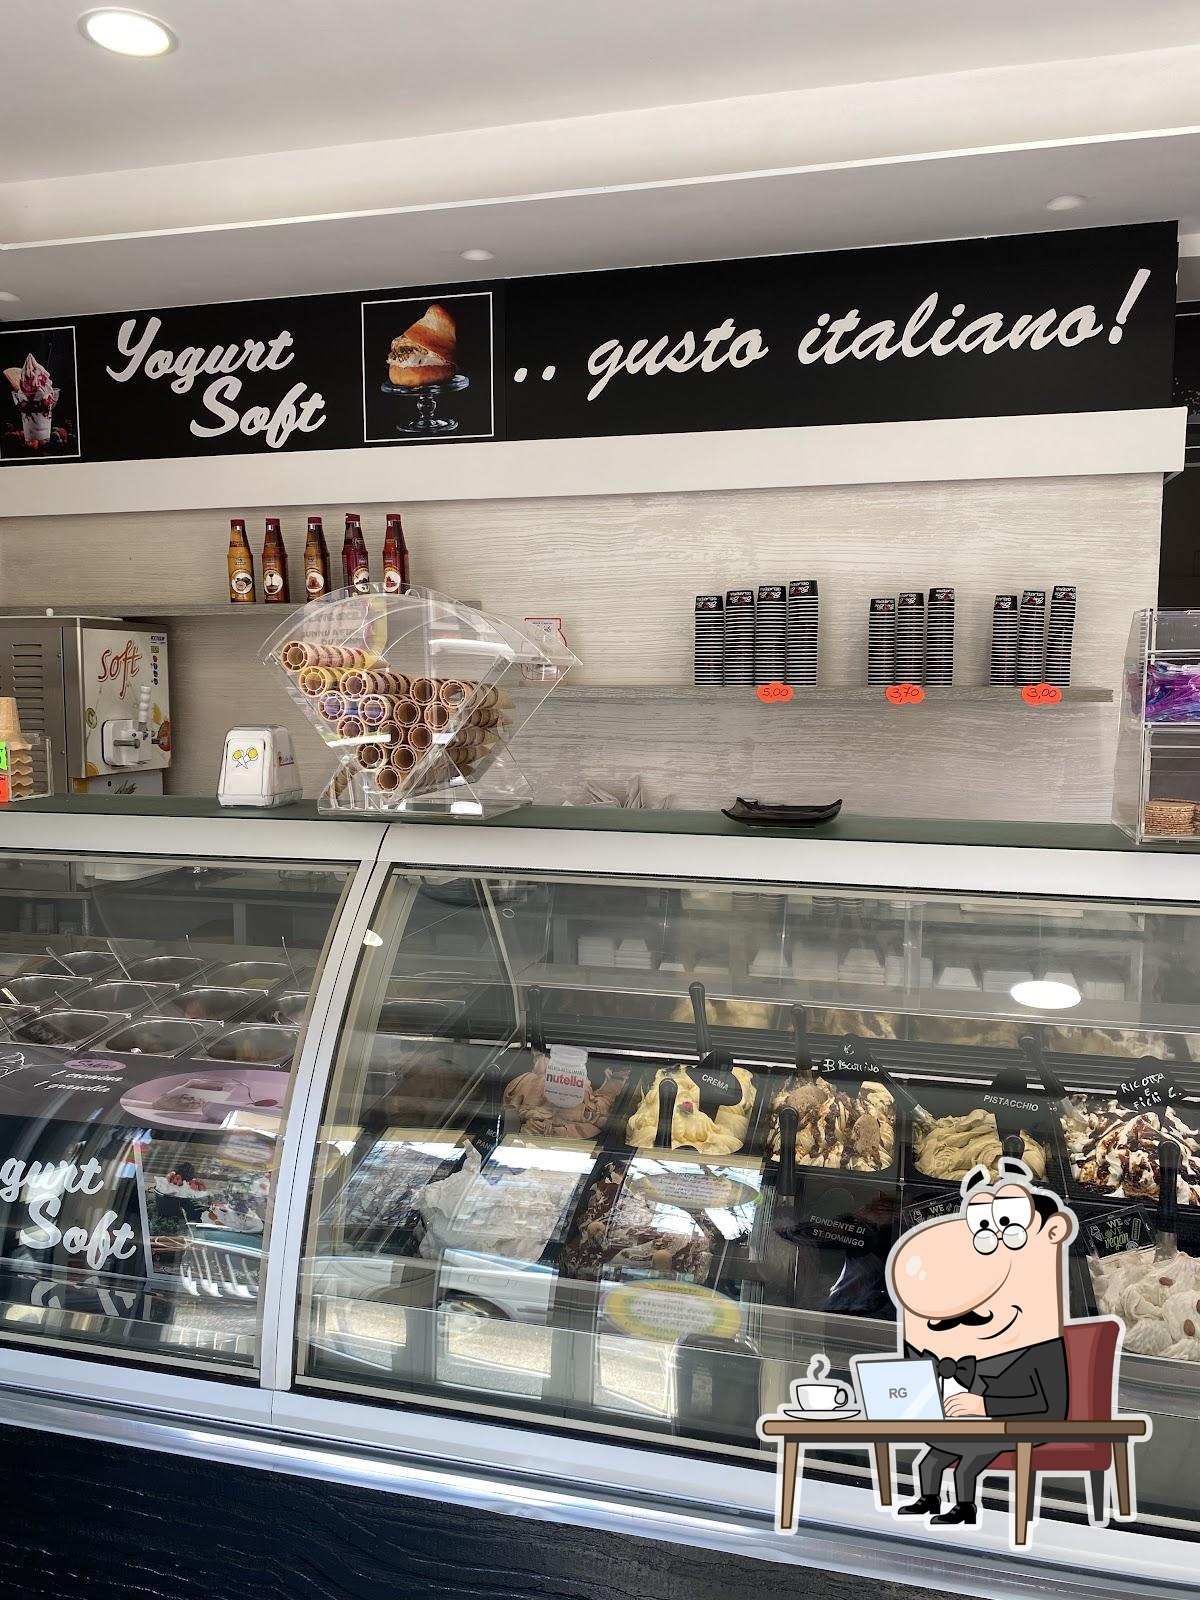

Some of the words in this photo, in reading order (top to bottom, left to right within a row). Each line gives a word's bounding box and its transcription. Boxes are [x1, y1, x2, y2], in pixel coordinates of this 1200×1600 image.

[587, 317, 769, 401] gusto
[797, 267, 1152, 365] italiano!
[106, 316, 295, 394] Yogurt
[190, 375, 327, 448] Soft
[762, 687, 789, 698] 5,00
[890, 686, 920, 703] 3,70
[1027, 687, 1057, 700] 3,00
[546, 1073, 584, 1088] nutella
[701, 1073, 729, 1092] CREMA
[1120, 1072, 1166, 1094] RICOTTA
[1144, 1087, 1151, 1097] E
[983, 1094, 1039, 1112] PISTACCHIO
[928, 1204, 945, 1214] WE
[19, 1193, 137, 1270] Soft
[809, 1215, 855, 1233] FONDENTE
[856, 1226, 867, 1235] DI
[1106, 1217, 1124, 1229] WE
[1104, 1231, 1130, 1251] vegan
